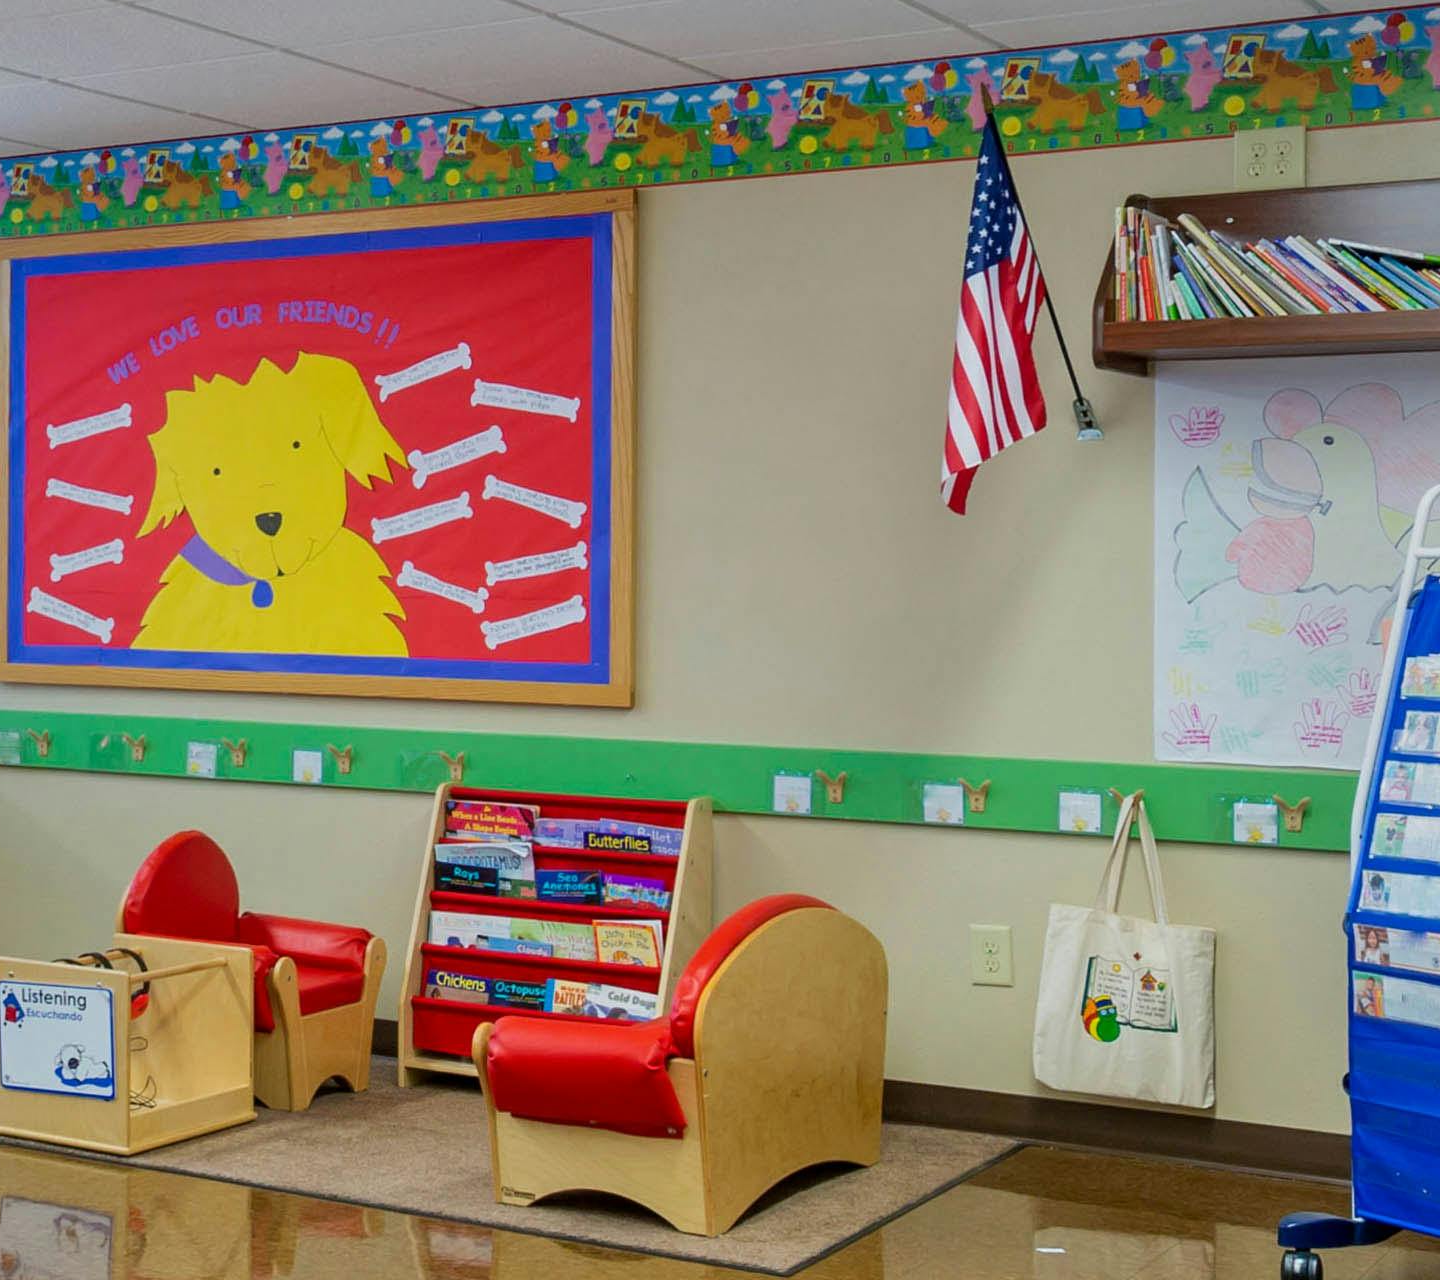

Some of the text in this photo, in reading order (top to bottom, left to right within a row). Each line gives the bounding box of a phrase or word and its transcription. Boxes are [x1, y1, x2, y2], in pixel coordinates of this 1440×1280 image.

[107, 352, 140, 384] WE
[149, 316, 201, 357] LOVE
[215, 303, 262, 329] OUR
[588, 833, 649, 851] Butterflies
[454, 867, 479, 880] Rays
[557, 873, 578, 882] Sea
[543, 881, 596, 892] Anemones
[436, 971, 486, 992] Chickens
[22, 988, 86, 1011] Listening
[608, 992, 629, 1003] Cold
[27, 1009, 82, 1021] Escuchando
